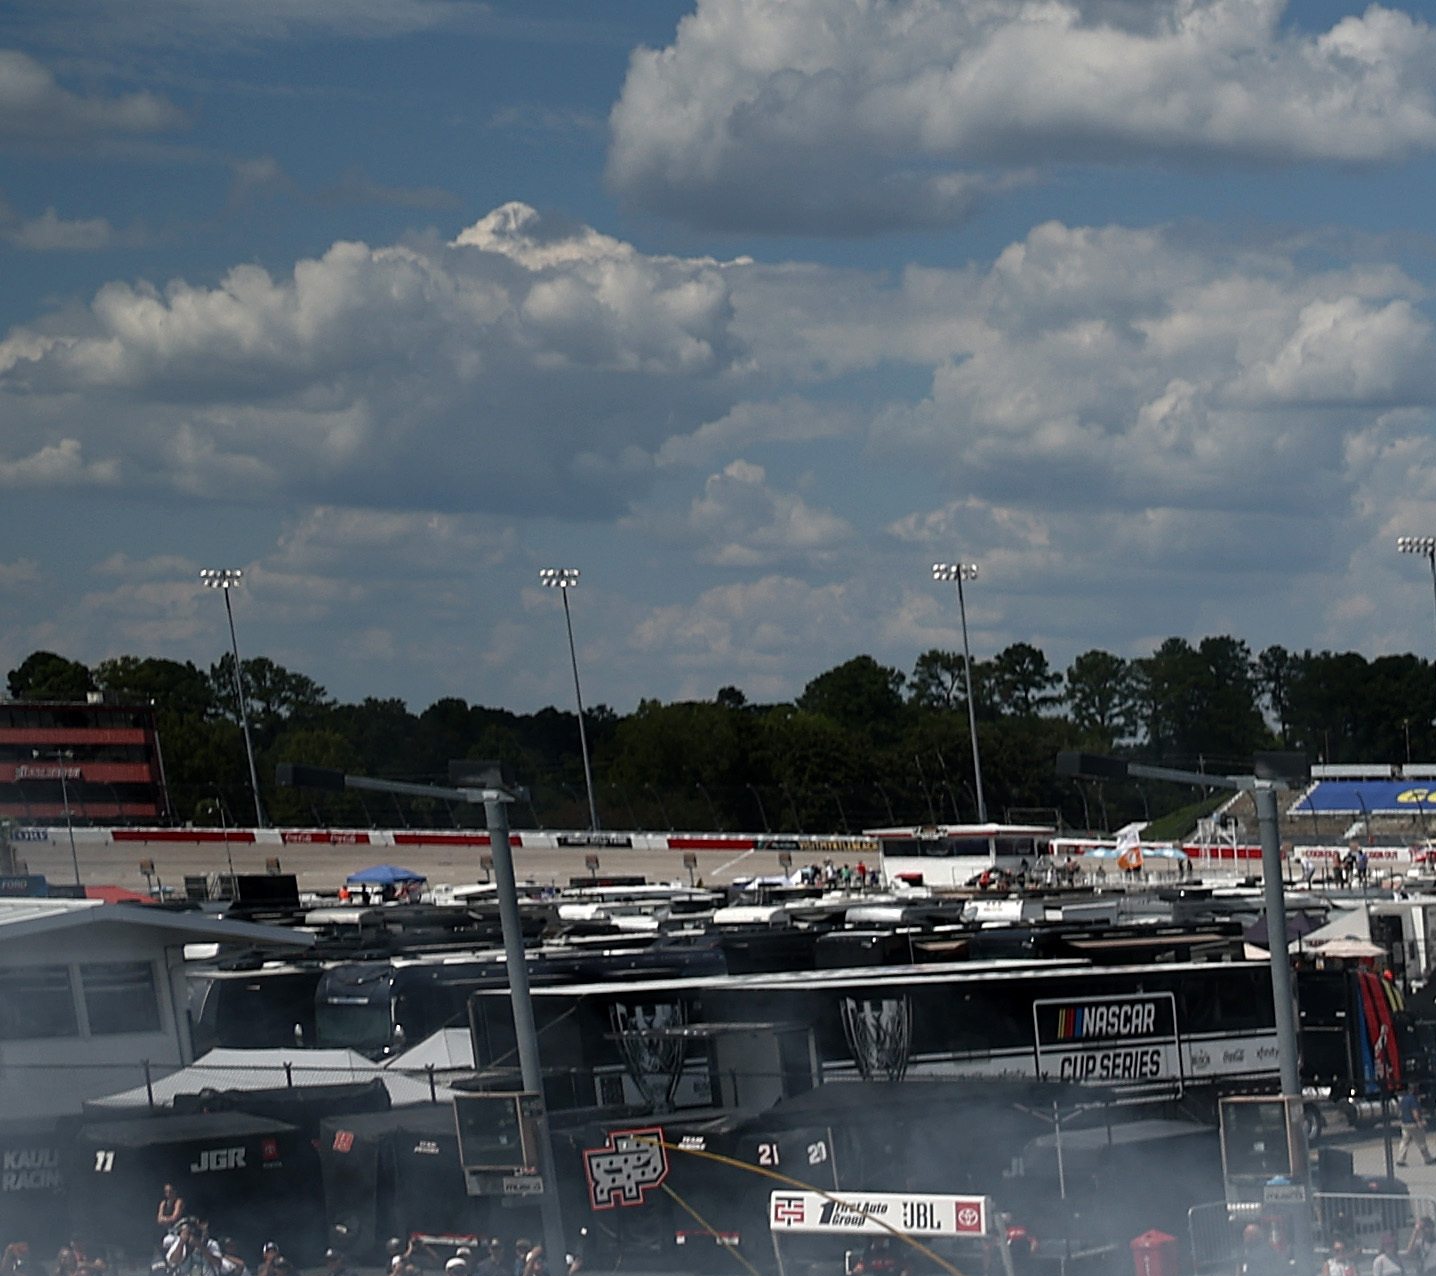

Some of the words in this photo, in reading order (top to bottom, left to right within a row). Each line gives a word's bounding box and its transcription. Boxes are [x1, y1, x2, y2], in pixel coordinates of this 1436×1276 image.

[1083, 1002, 1156, 1038] NASCAR
[1060, 1054, 1097, 1083] CUP
[1099, 1049, 1162, 1081] SERIES
[3, 1148, 59, 1169] KAULI
[94, 1150, 116, 1173] 11
[190, 1146, 247, 1173] JGR
[2, 1169, 62, 1191] RACIN
[862, 1203, 889, 1215] Auto
[903, 1201, 942, 1230] JBL
[831, 1213, 866, 1229] Group
